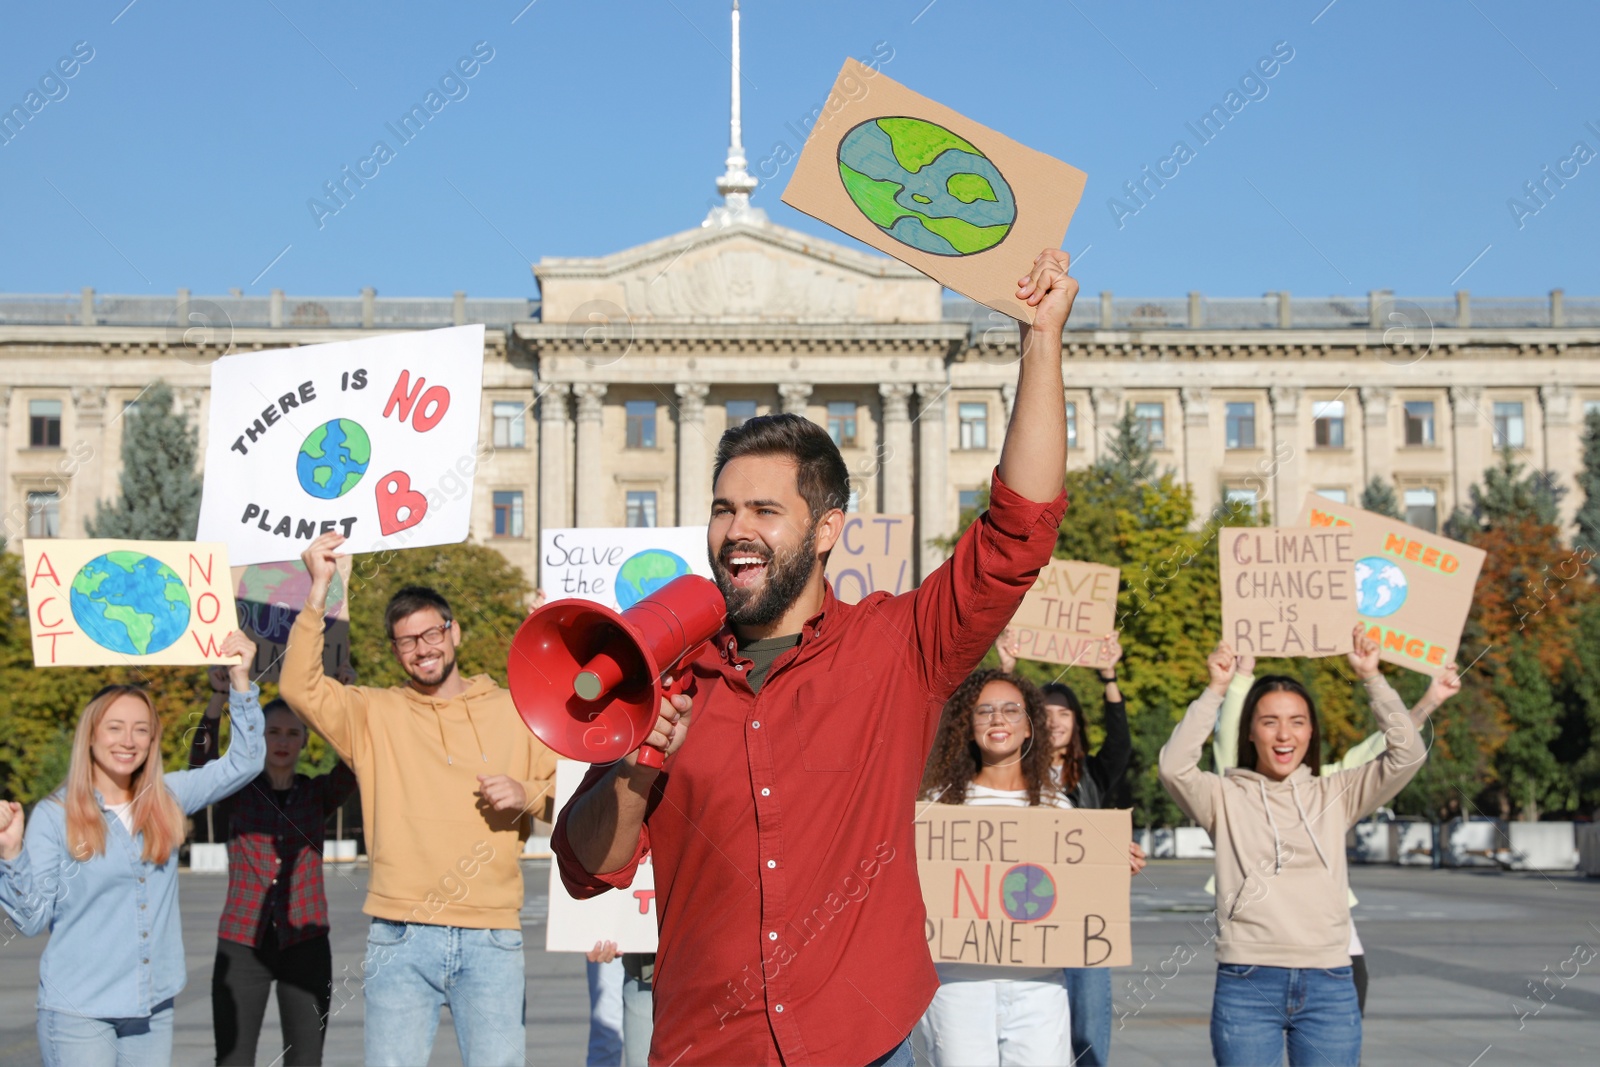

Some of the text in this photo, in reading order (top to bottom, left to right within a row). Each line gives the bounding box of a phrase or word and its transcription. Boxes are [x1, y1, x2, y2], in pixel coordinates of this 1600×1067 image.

[231, 368, 451, 456] THERE IS NO
[375, 470, 428, 536] B
[546, 533, 624, 567] Save
[843, 517, 903, 555] CT
[1384, 532, 1459, 574] NEED
[561, 568, 606, 594] the
[1235, 570, 1348, 600] CHANGE
[1040, 597, 1094, 634] THE
[1235, 619, 1337, 652] REAL
[1358, 620, 1447, 666] ANGE
[1084, 914, 1112, 967] B
